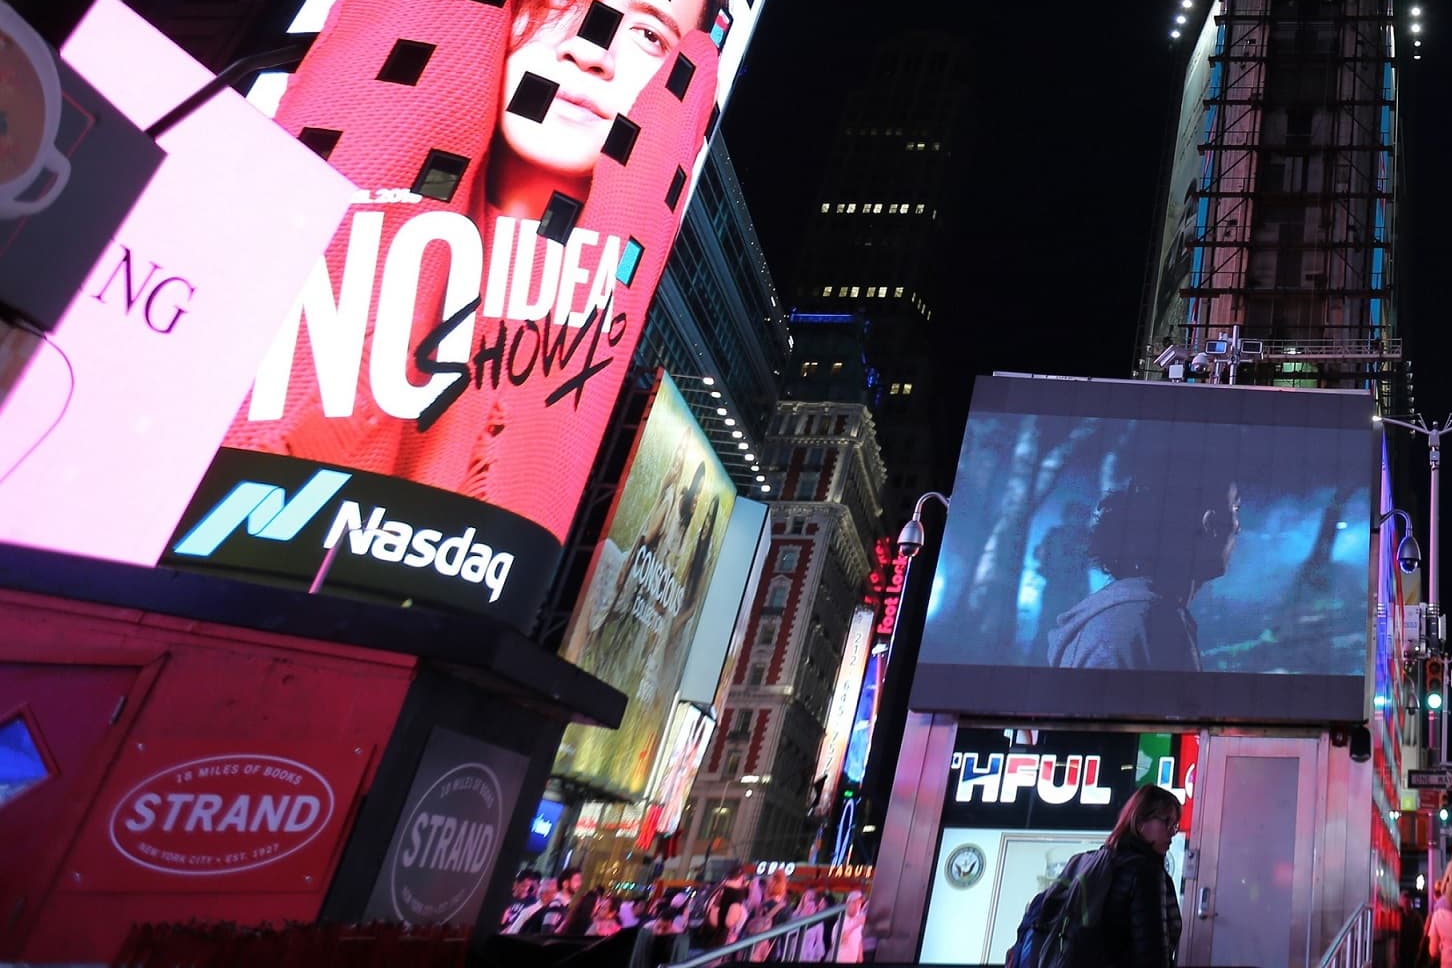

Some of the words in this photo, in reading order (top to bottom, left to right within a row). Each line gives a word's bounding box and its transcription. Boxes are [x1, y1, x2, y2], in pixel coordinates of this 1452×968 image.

[88, 244, 198, 334] NG
[247, 210, 484, 421] NO
[482, 215, 622, 333] IDEA
[323, 500, 515, 603] Nasdaq
[633, 545, 687, 617] CONSCIOUS
[886, 556, 907, 593] Lock
[877, 597, 897, 634] Foot
[198, 764, 239, 778] MILES
[244, 764, 260, 775] OF
[263, 767, 303, 785] BOOKS
[125, 792, 321, 833] STRAND
[403, 812, 495, 873] STRAND
